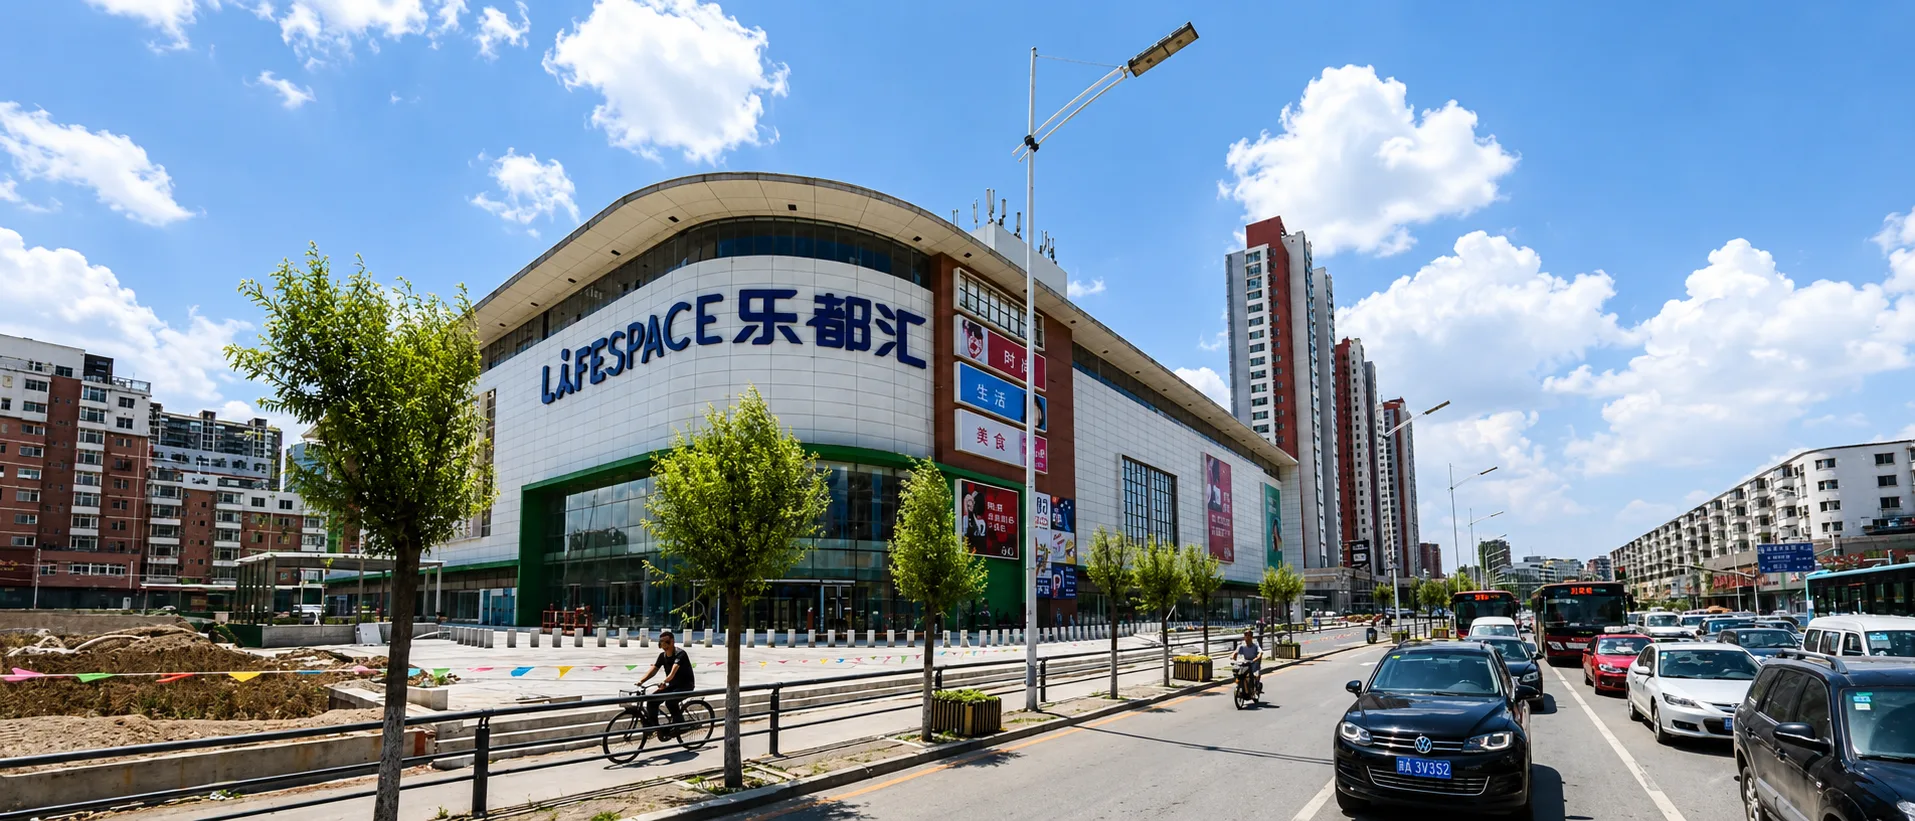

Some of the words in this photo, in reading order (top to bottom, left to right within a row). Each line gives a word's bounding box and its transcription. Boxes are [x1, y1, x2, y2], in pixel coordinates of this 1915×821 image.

[732, 288, 927, 370] 乐都汇
[976, 383, 1006, 409] 生活
[976, 427, 1006, 452] 美食
